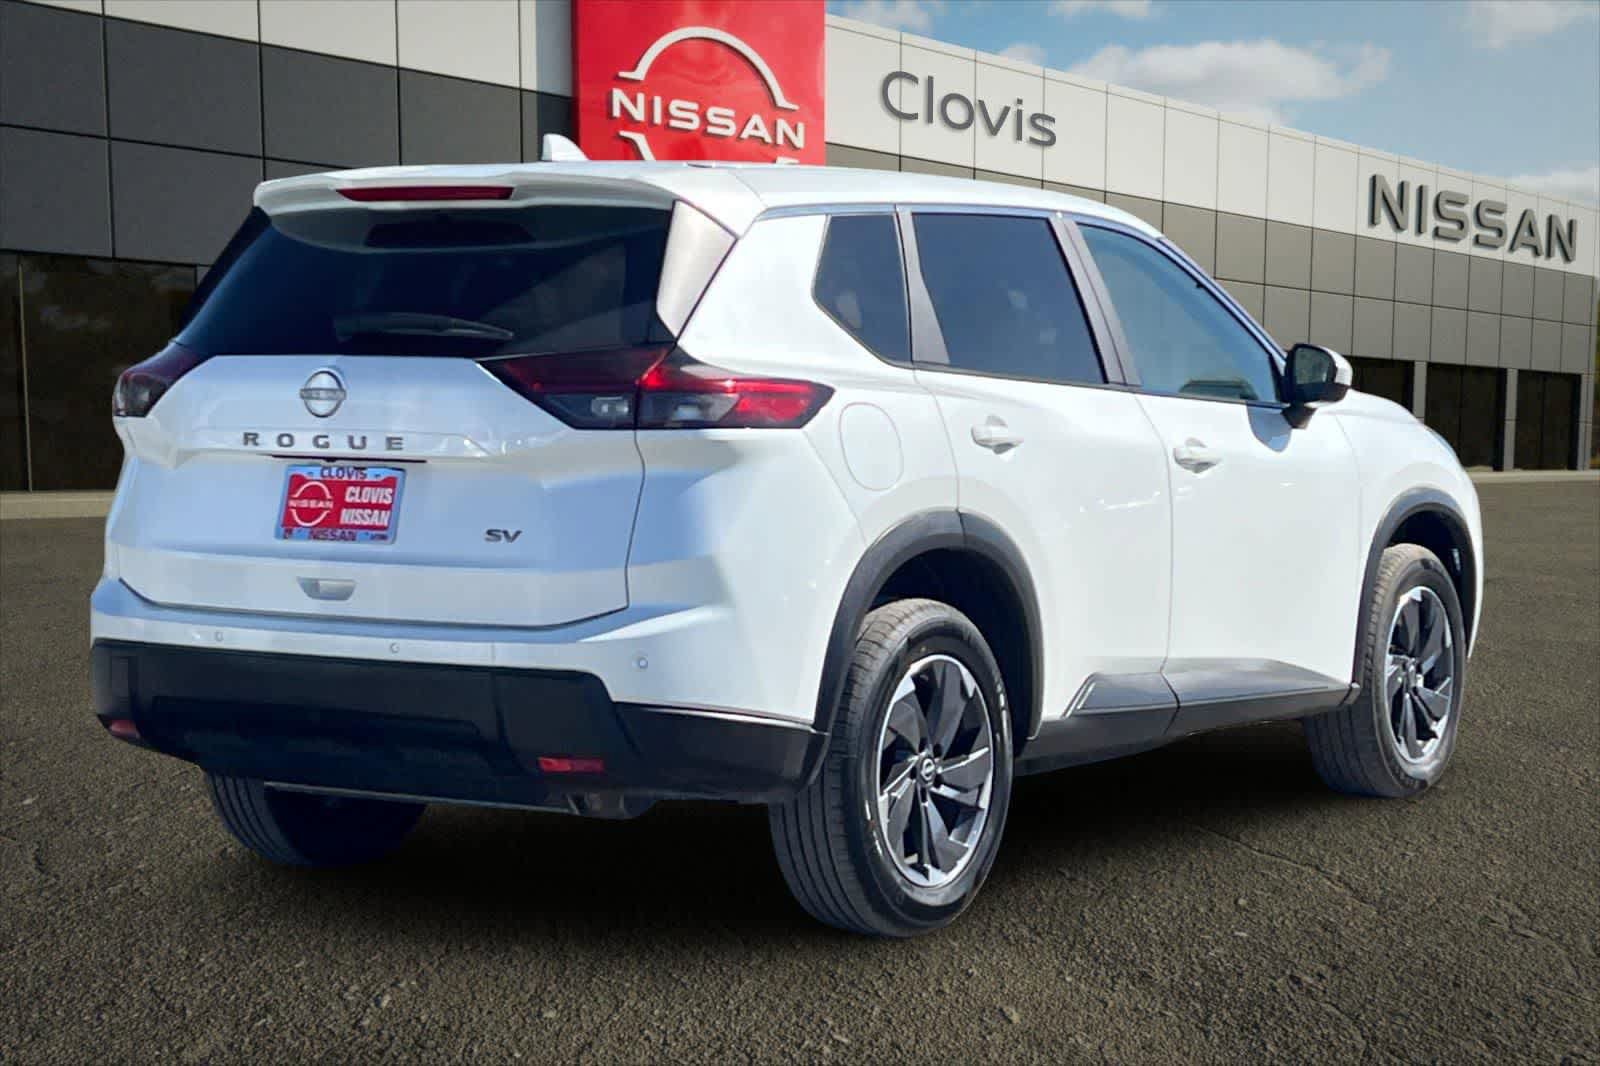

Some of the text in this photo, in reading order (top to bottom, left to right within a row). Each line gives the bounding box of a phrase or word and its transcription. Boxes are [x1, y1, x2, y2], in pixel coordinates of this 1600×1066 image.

[610, 87, 805, 149] NISSAN
[882, 71, 1057, 147] Clovis
[1368, 173, 1577, 264] NISSAN
[242, 432, 405, 452] ROGUE
[320, 466, 367, 479] CLOVIS
[345, 486, 393, 504] CLOVIS
[339, 508, 391, 527] NISSAN
[484, 529, 523, 544] SV
